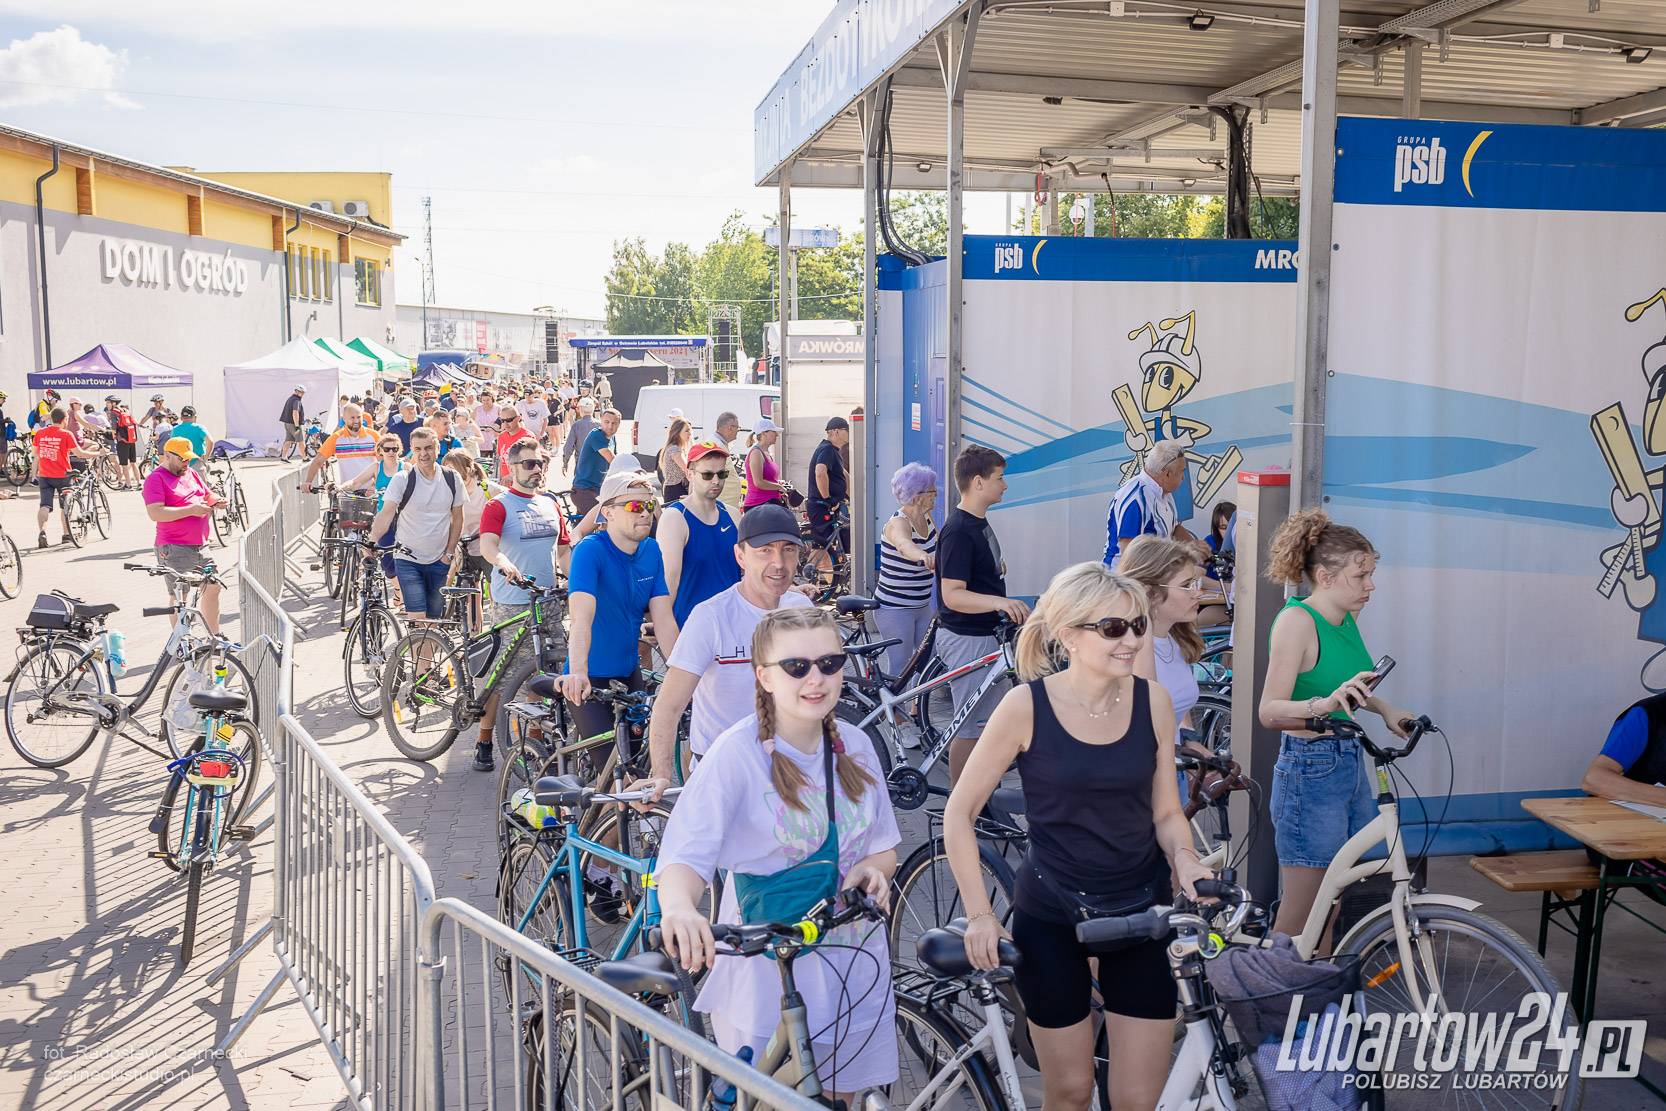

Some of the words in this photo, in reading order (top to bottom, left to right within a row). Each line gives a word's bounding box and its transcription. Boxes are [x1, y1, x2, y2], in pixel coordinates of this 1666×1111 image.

[1397, 136, 1426, 144] GRUPA
[1393, 137, 1447, 193] psb
[104, 239, 160, 283] DOM
[167, 248, 176, 288] I
[181, 247, 248, 295] OGRÓD
[994, 244, 1023, 273] psb
[42, 377, 117, 387] www.lubartow.pl
[930, 686, 984, 760] ROMET
